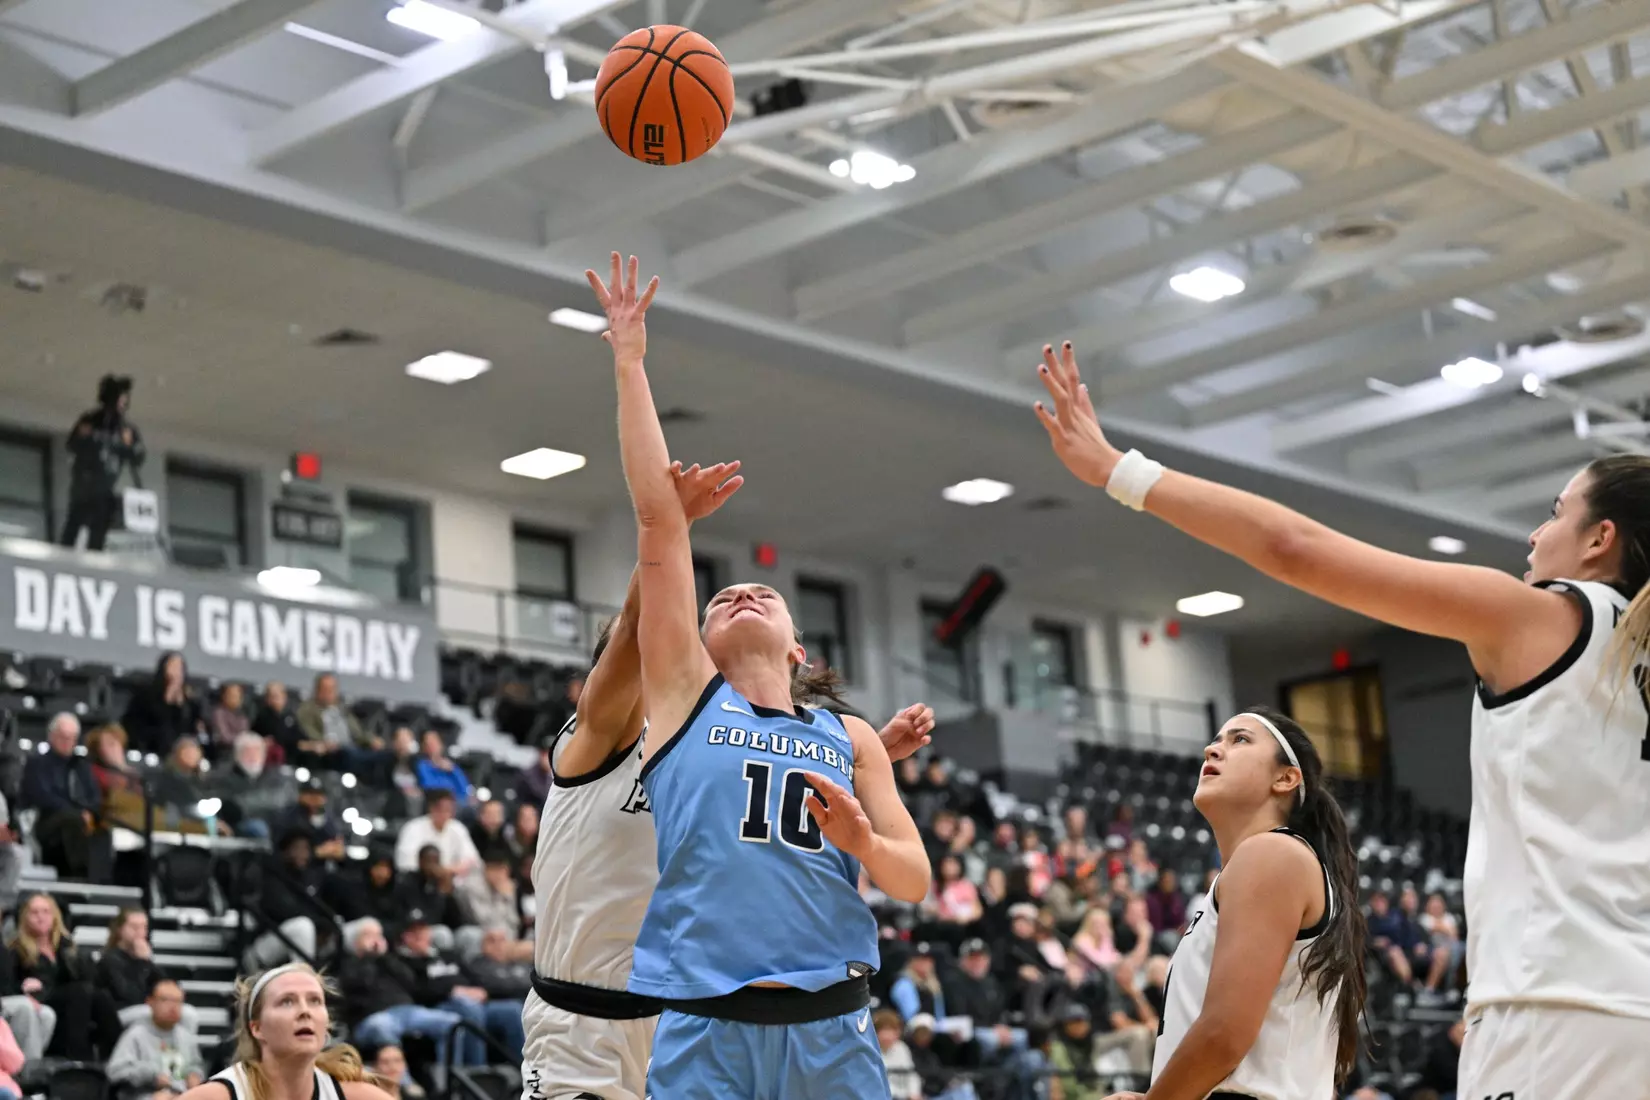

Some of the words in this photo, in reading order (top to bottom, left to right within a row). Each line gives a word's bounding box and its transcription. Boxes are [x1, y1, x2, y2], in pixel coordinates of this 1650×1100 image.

[14, 566, 118, 640] DAY
[136, 584, 187, 650] IS
[198, 594, 420, 681] GAMEDAY
[739, 759, 832, 853] 10
